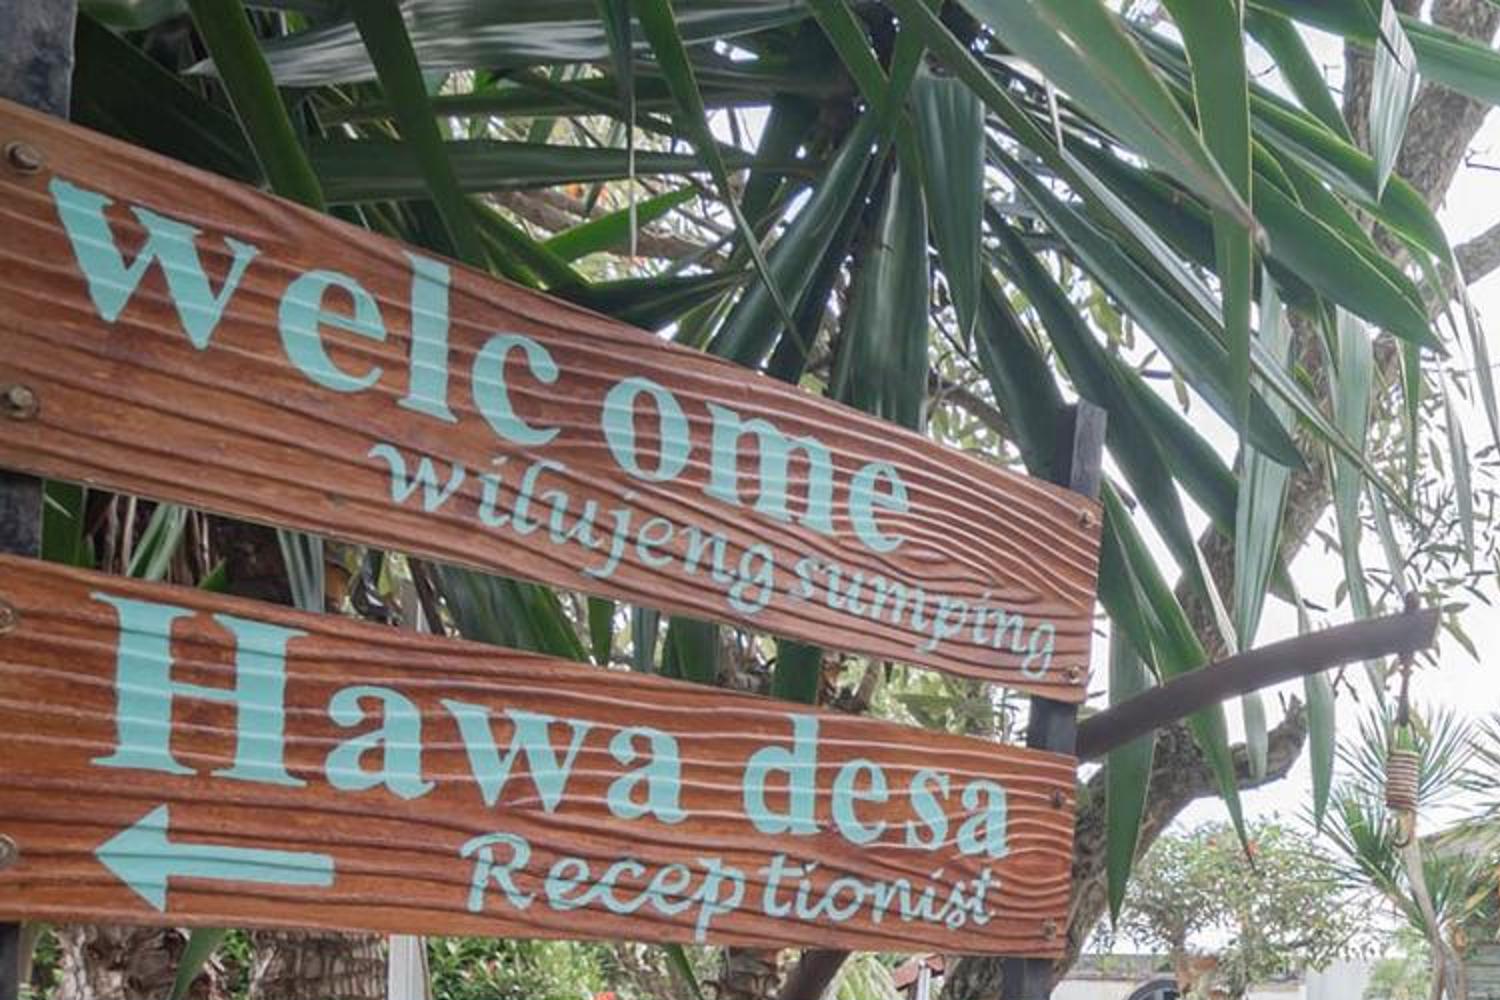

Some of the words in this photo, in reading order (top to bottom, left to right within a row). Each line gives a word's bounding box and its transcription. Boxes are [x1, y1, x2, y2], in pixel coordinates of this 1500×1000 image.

[368, 442, 777, 616] wilujeng
[791, 553, 1057, 678] sumping
[91, 592, 690, 826] Hawa
[743, 714, 1013, 861] desa
